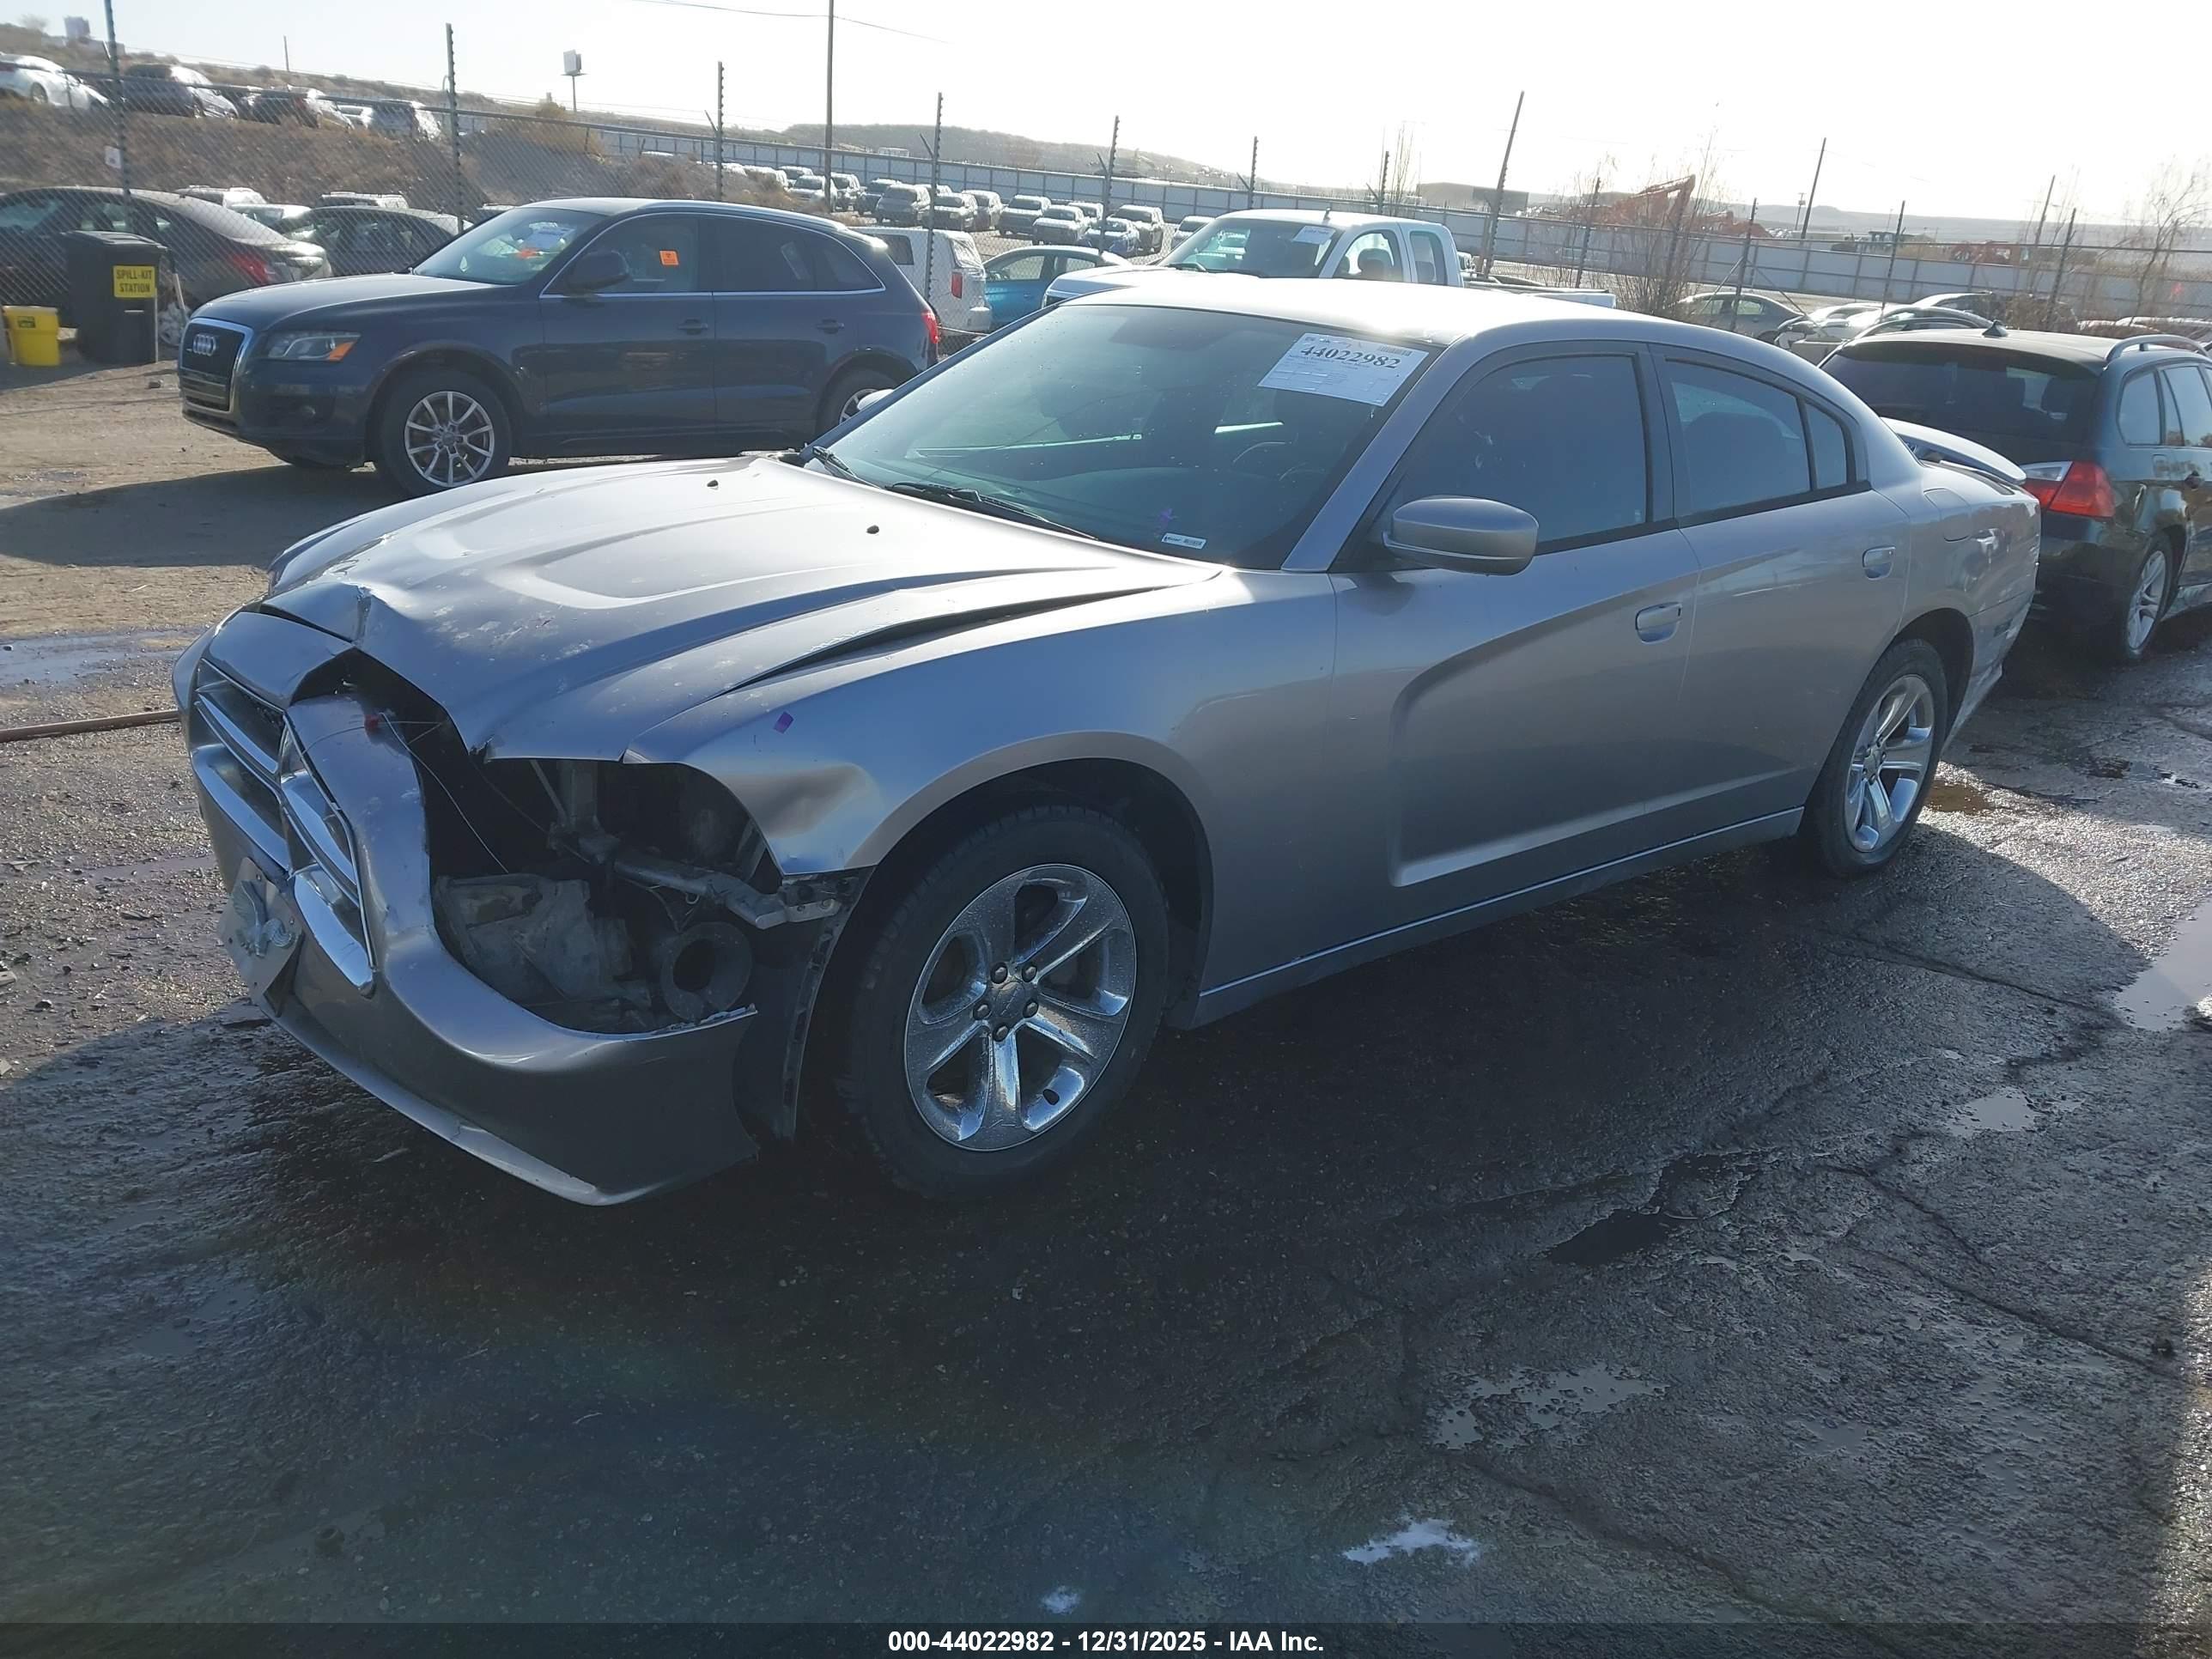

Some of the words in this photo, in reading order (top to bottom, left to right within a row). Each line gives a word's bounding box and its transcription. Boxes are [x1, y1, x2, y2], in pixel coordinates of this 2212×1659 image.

[116, 269, 152, 279] SPILL-KIT
[119, 283, 151, 293] STATION
[1300, 345, 1401, 369] 44022982
